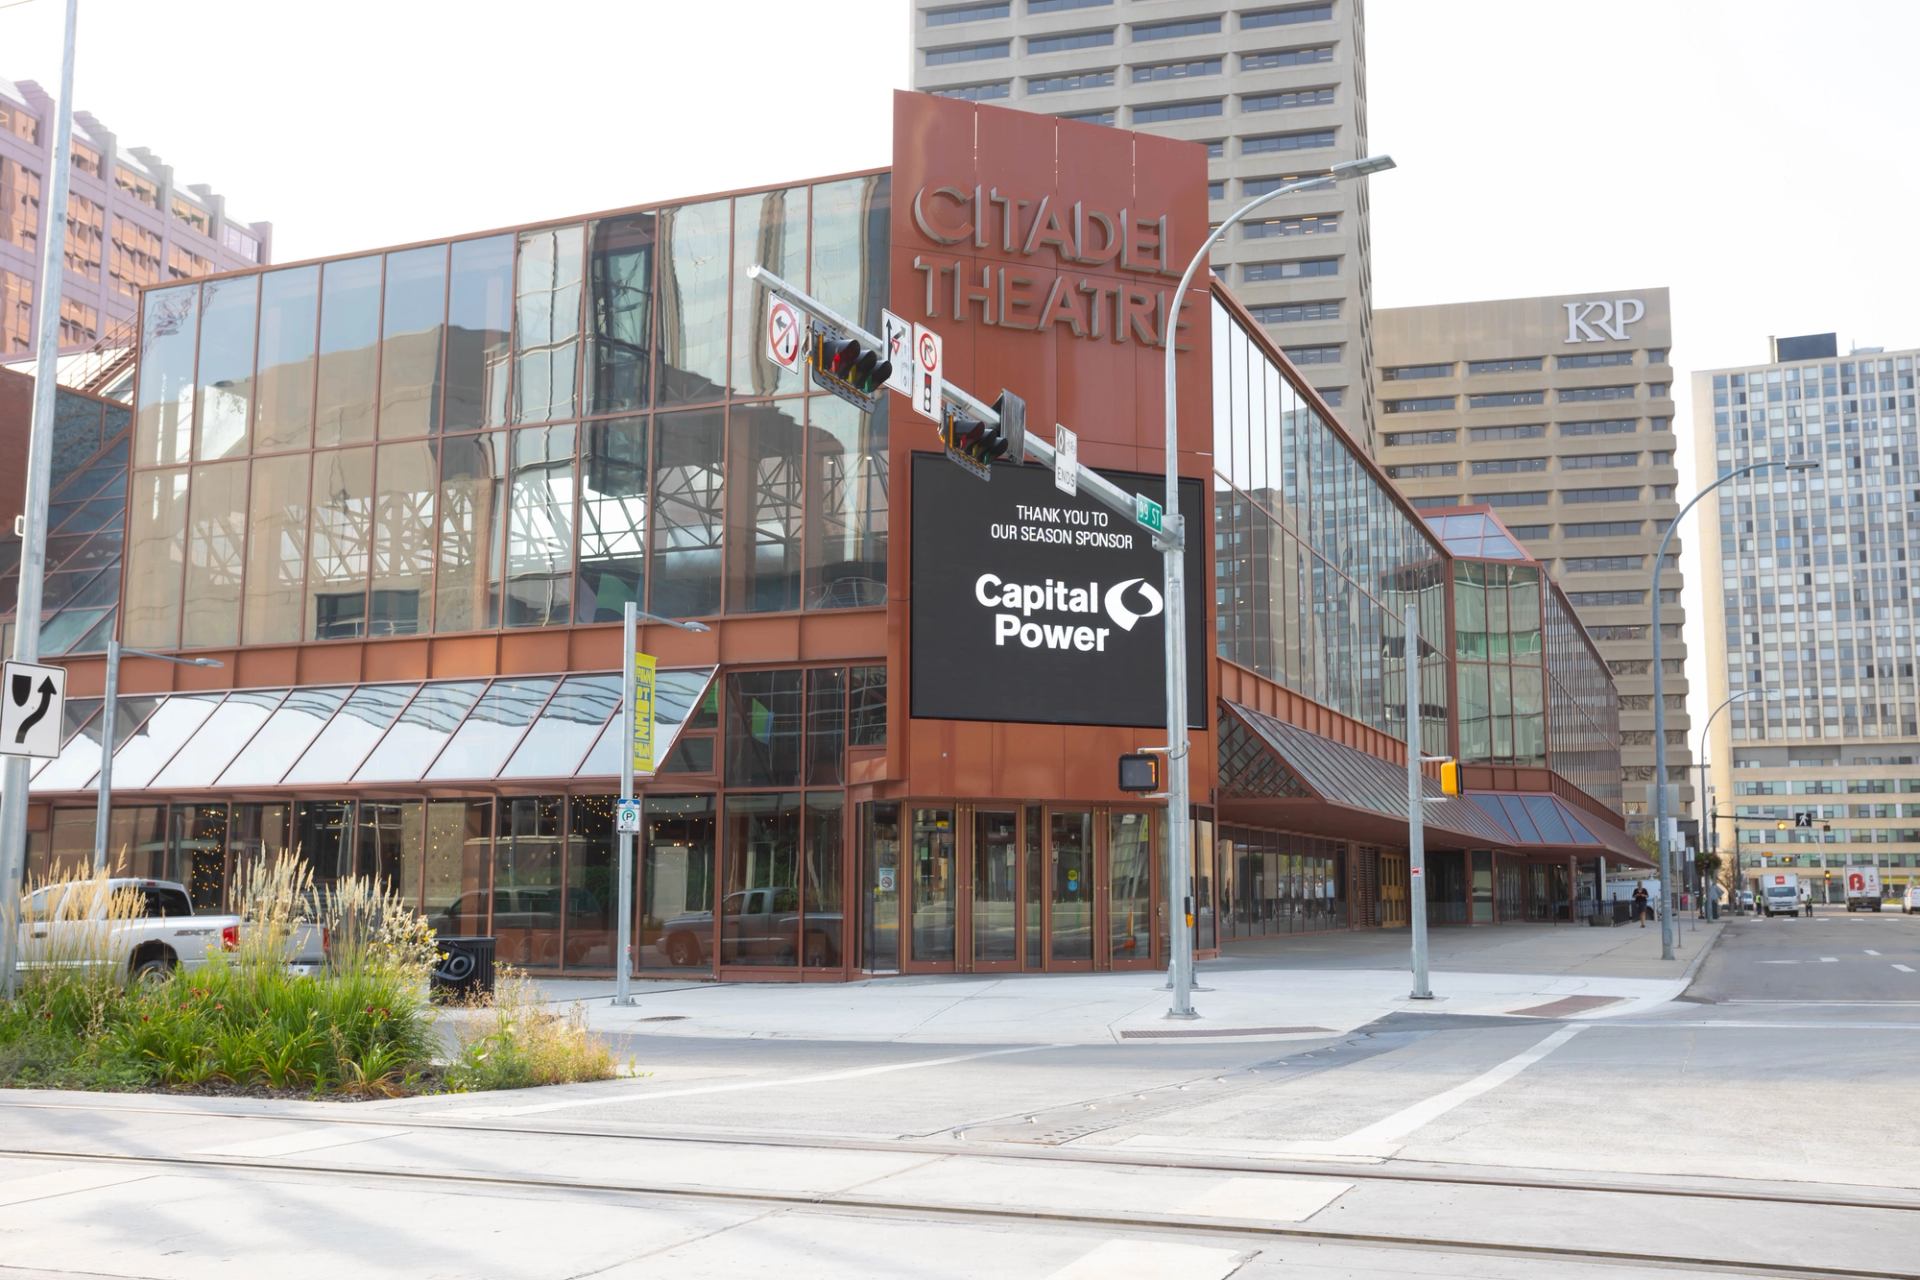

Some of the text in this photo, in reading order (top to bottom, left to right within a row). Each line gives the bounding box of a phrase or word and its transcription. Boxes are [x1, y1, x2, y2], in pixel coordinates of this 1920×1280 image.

[912, 183, 1188, 278] CITADEL
[914, 254, 1195, 351] THEATRE
[1563, 298, 1645, 343] KRP
[1057, 466, 1075, 487] ENDS
[1016, 504, 1109, 527] THANK YOU TO
[1139, 500, 1160, 526] 99 ST
[991, 523, 1133, 550] OUR SEASON SPONSOR
[975, 573, 1098, 616] Capital
[995, 613, 1110, 652] Power
